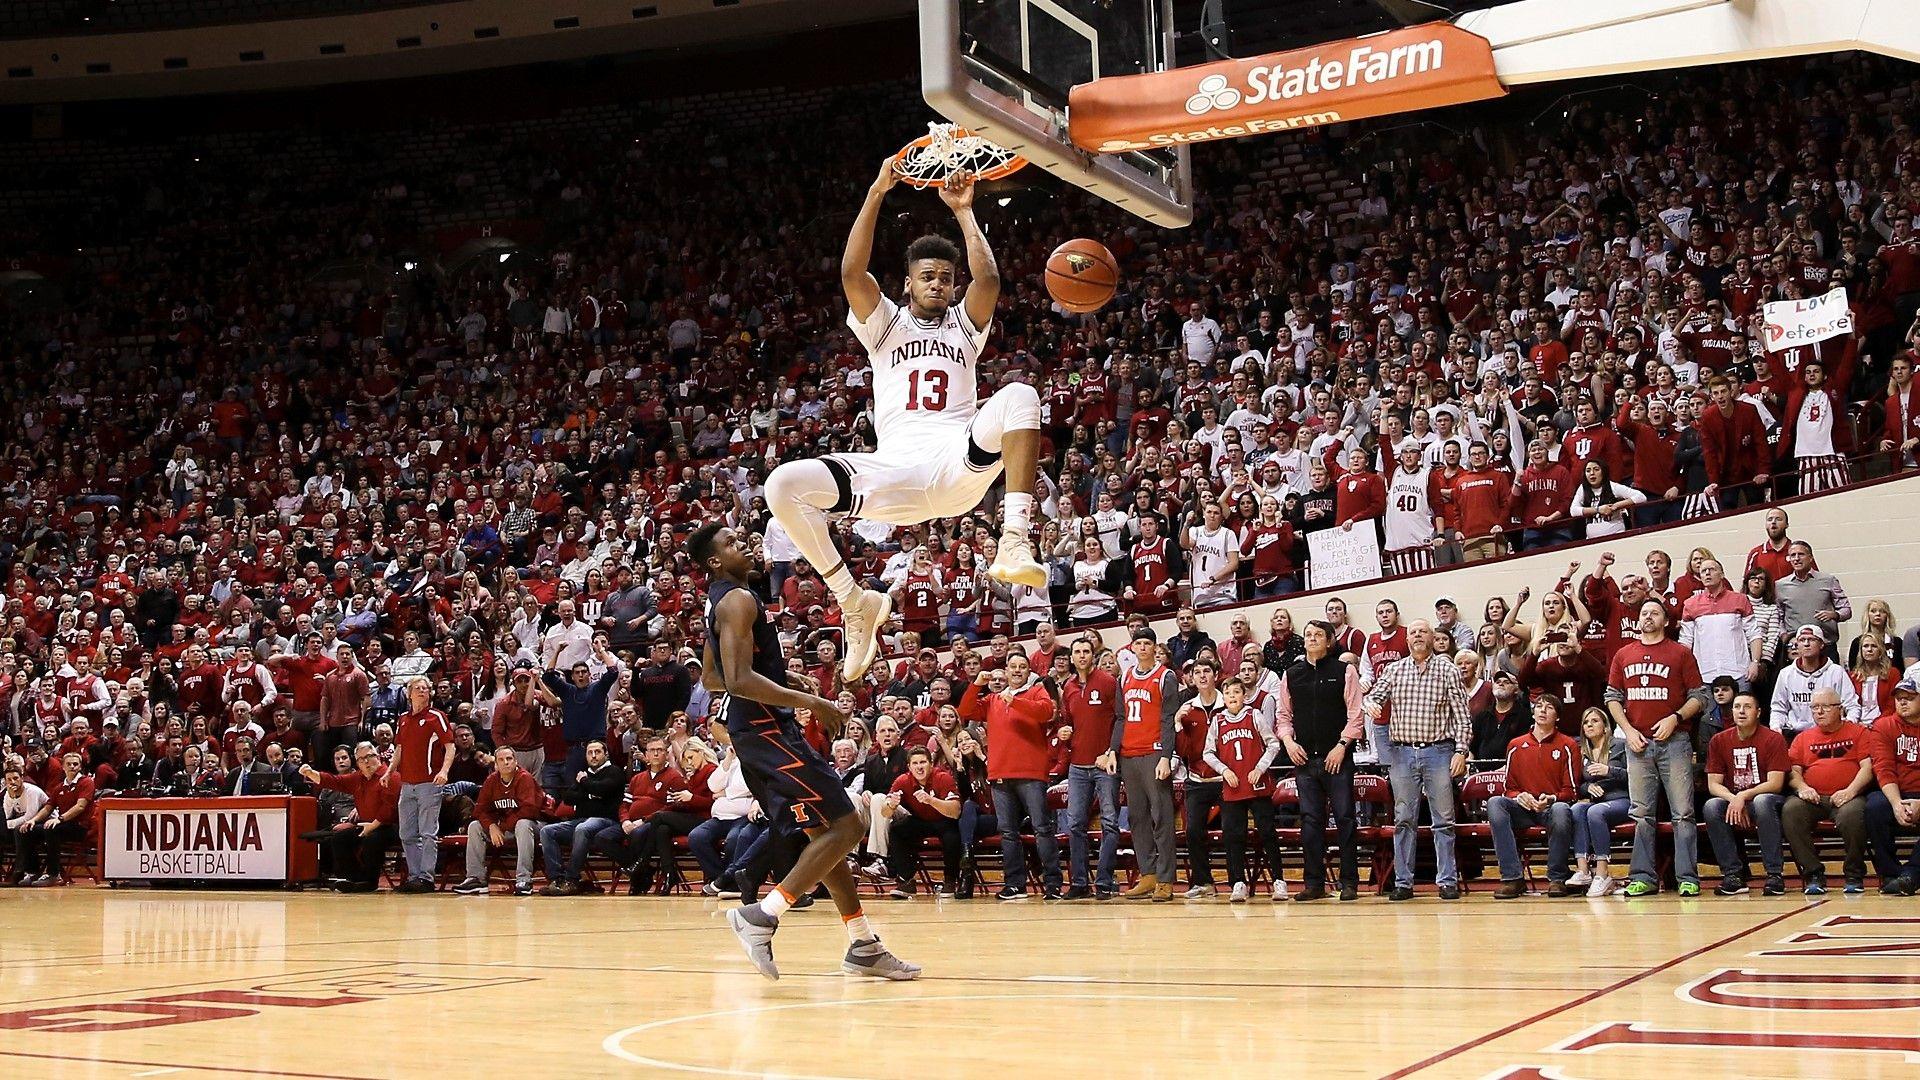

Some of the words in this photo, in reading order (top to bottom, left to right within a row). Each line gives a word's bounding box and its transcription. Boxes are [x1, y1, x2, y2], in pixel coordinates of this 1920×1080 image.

[482, 225, 492, 237] H
[1766, 303, 1776, 315] I
[1795, 288, 1842, 313] LOVE
[1770, 317, 1848, 342] Defense
[891, 339, 967, 369] INDIANA
[905, 369, 949, 412] 13
[1392, 483, 1423, 496] INDIANA
[1396, 495, 1417, 512] 40
[1134, 554, 1163, 568] INDIANA
[1144, 564, 1151, 581] 1
[907, 581, 933, 593] INDIAN
[917, 591, 928, 607] 2
[983, 590, 989, 606] 1
[582, 598, 602, 626] IU
[1623, 662, 1670, 679] INDIANA
[1125, 688, 1152, 703] INDIANA
[1627, 687, 1669, 701] HOOSIERS
[1791, 692, 1812, 703] INDI
[1127, 700, 1141, 722] 11
[1221, 728, 1254, 745] INDIANA
[1234, 740, 1243, 761] 1
[1353, 778, 1377, 787] DIANA
[790, 801, 810, 824] I
[125, 812, 263, 851] INDIANA
[140, 853, 246, 874] BASKETBALL
